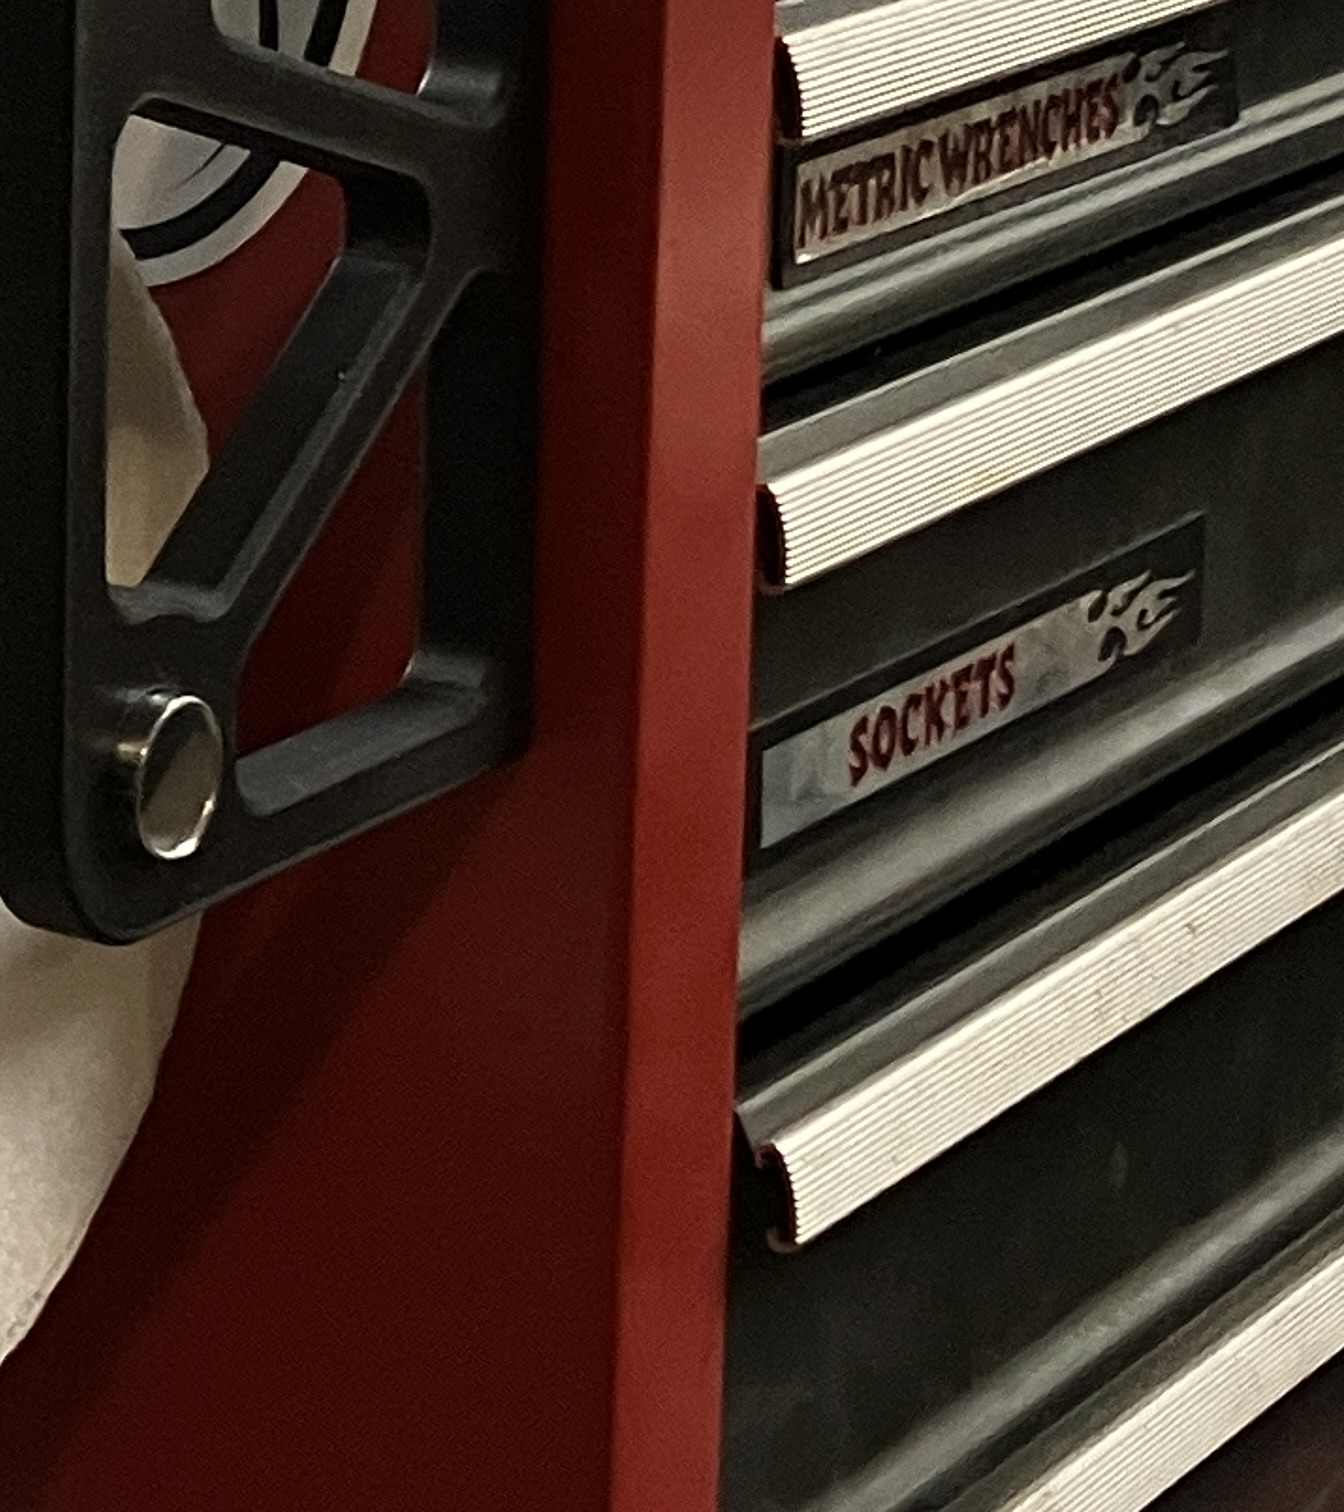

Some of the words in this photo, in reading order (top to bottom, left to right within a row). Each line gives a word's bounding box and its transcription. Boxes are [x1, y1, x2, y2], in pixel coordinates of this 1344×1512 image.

[795, 137, 936, 251] METRIC
[938, 70, 1124, 200] WRENCHES
[847, 643, 1016, 788] SOCKETS
